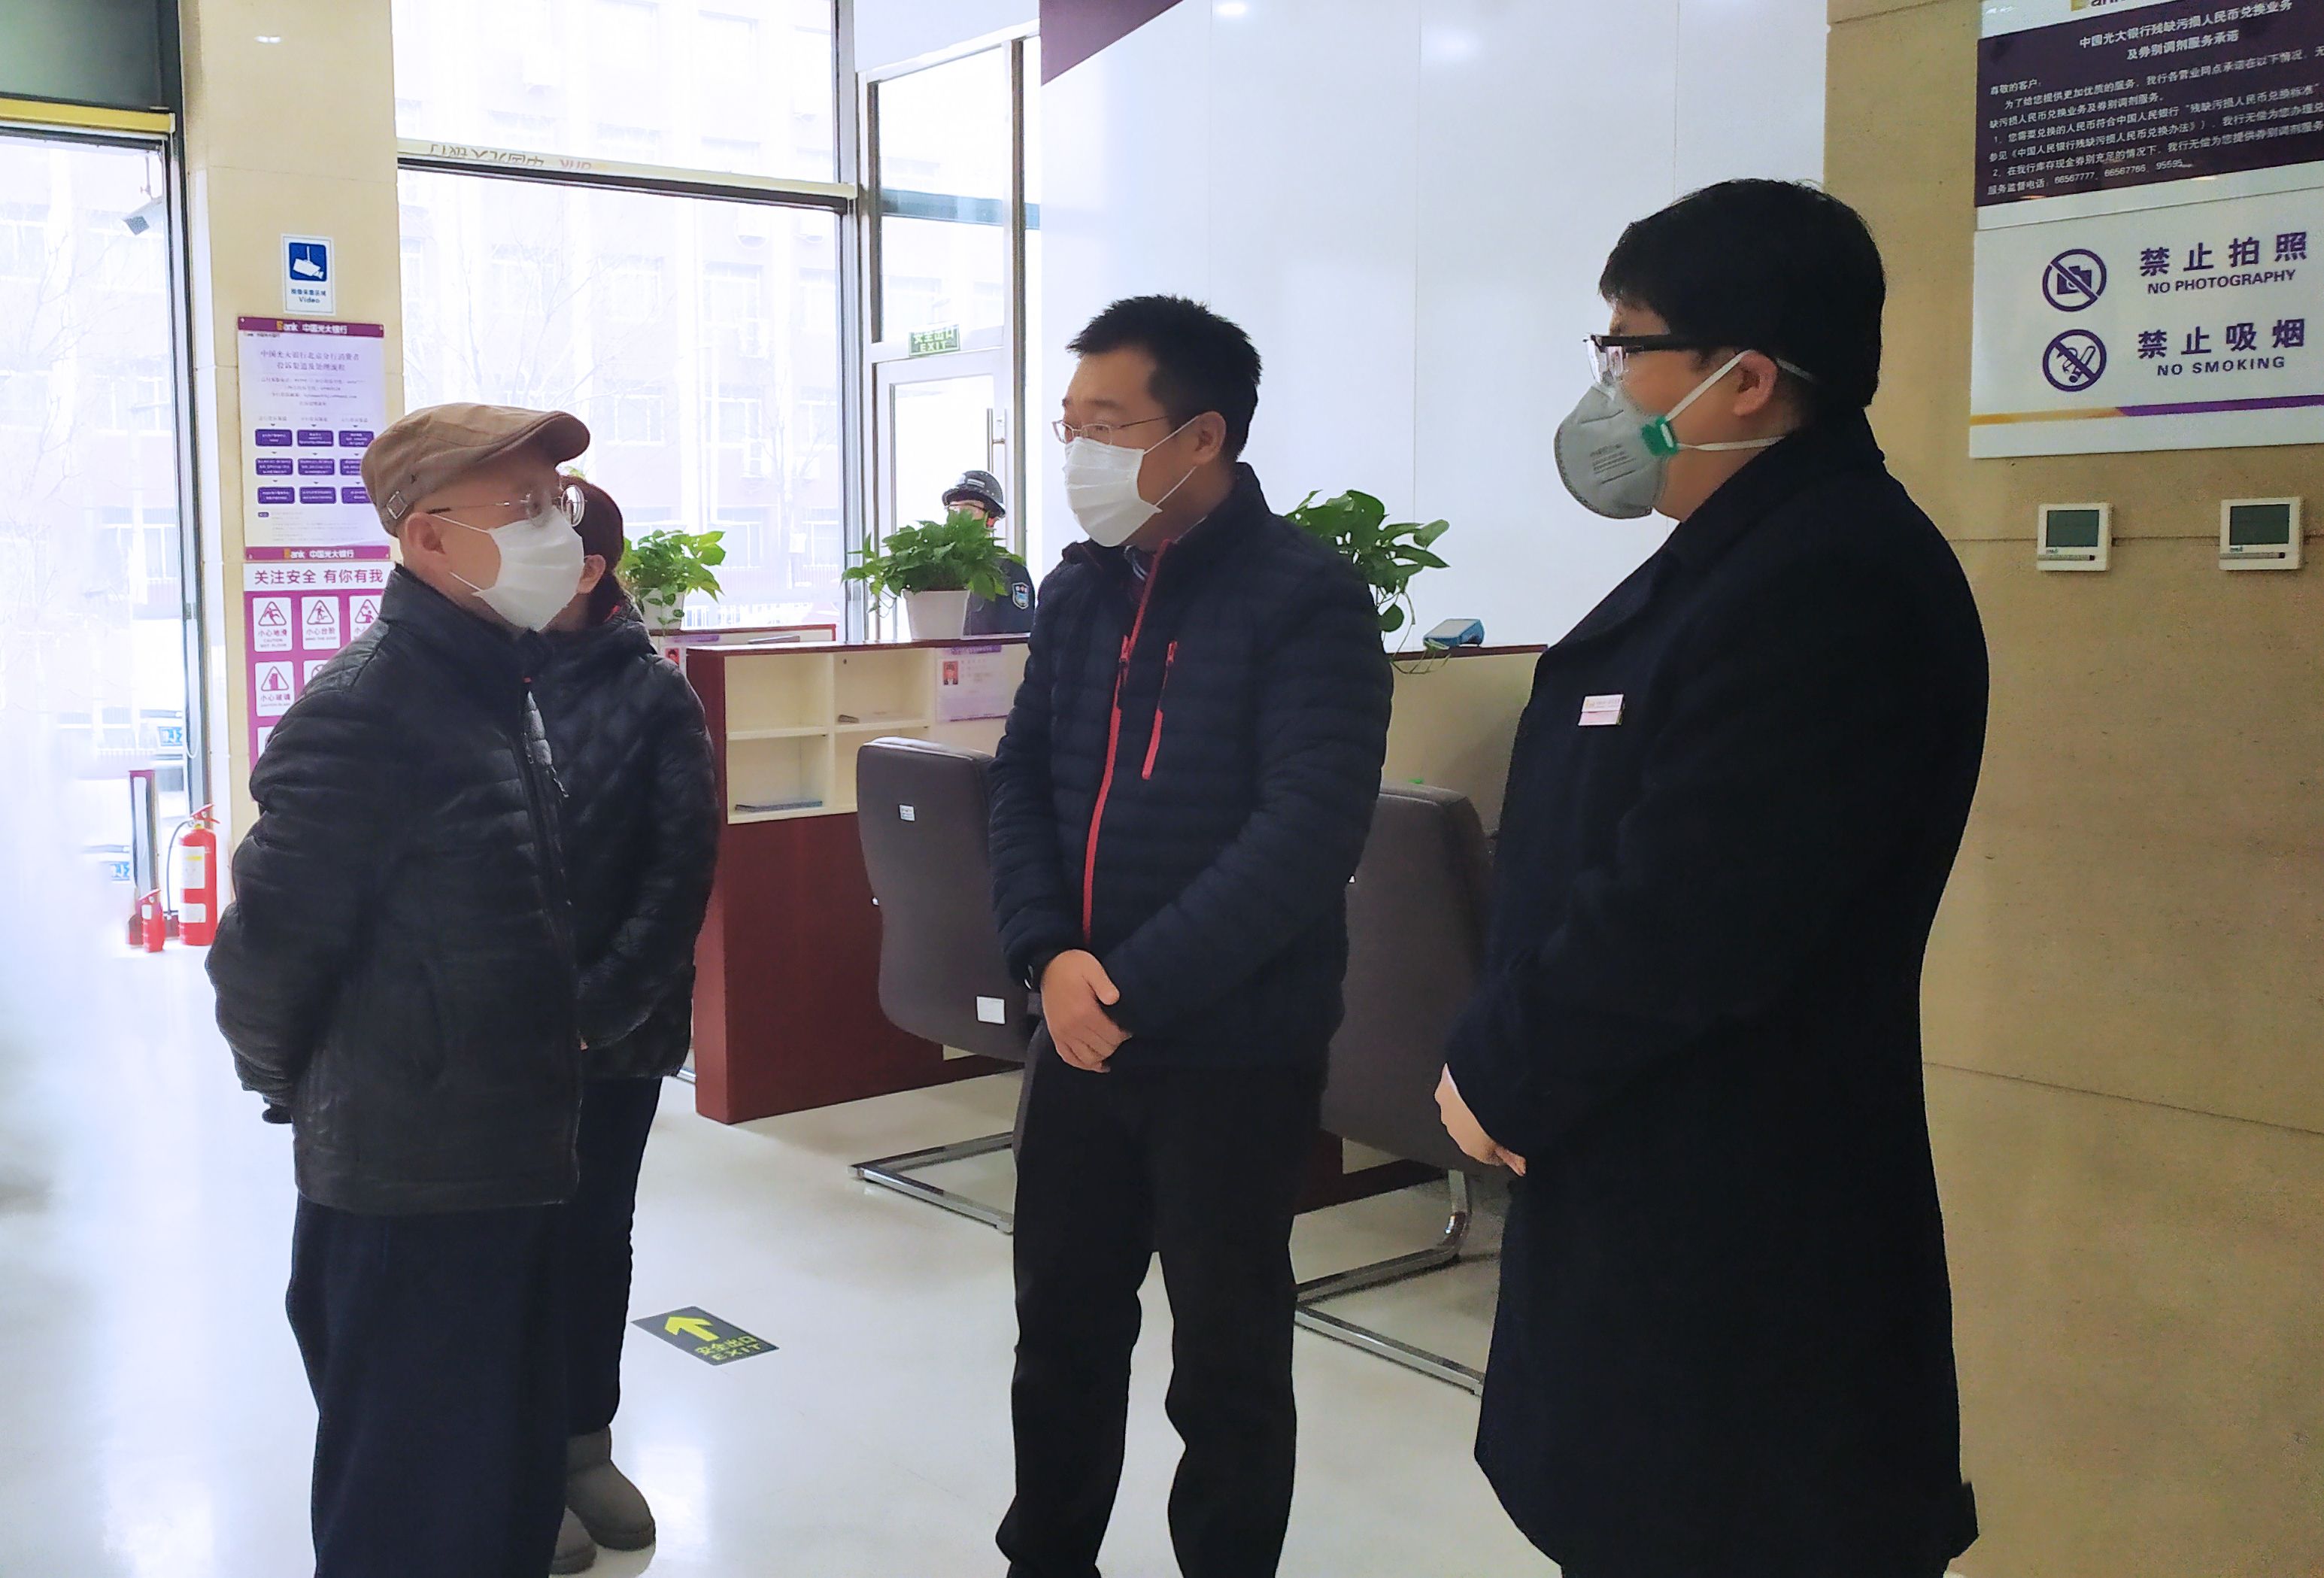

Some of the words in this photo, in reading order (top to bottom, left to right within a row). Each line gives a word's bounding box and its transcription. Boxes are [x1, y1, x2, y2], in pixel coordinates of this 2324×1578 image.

[2140, 232, 2307, 276] 禁止拍照
[2148, 281, 2171, 294] NO
[2175, 269, 2296, 291] PHOTOGRAPHY
[920, 340, 947, 352] EXIT
[2137, 318, 2305, 359] 禁止吸烟
[2157, 363, 2183, 376] NO
[2192, 356, 2285, 374] SMOKING
[254, 569, 317, 584] 关注安全
[323, 569, 384, 584] 有你有我
[694, 1335, 757, 1355] 安全出口
[711, 1343, 761, 1361] EXIT
